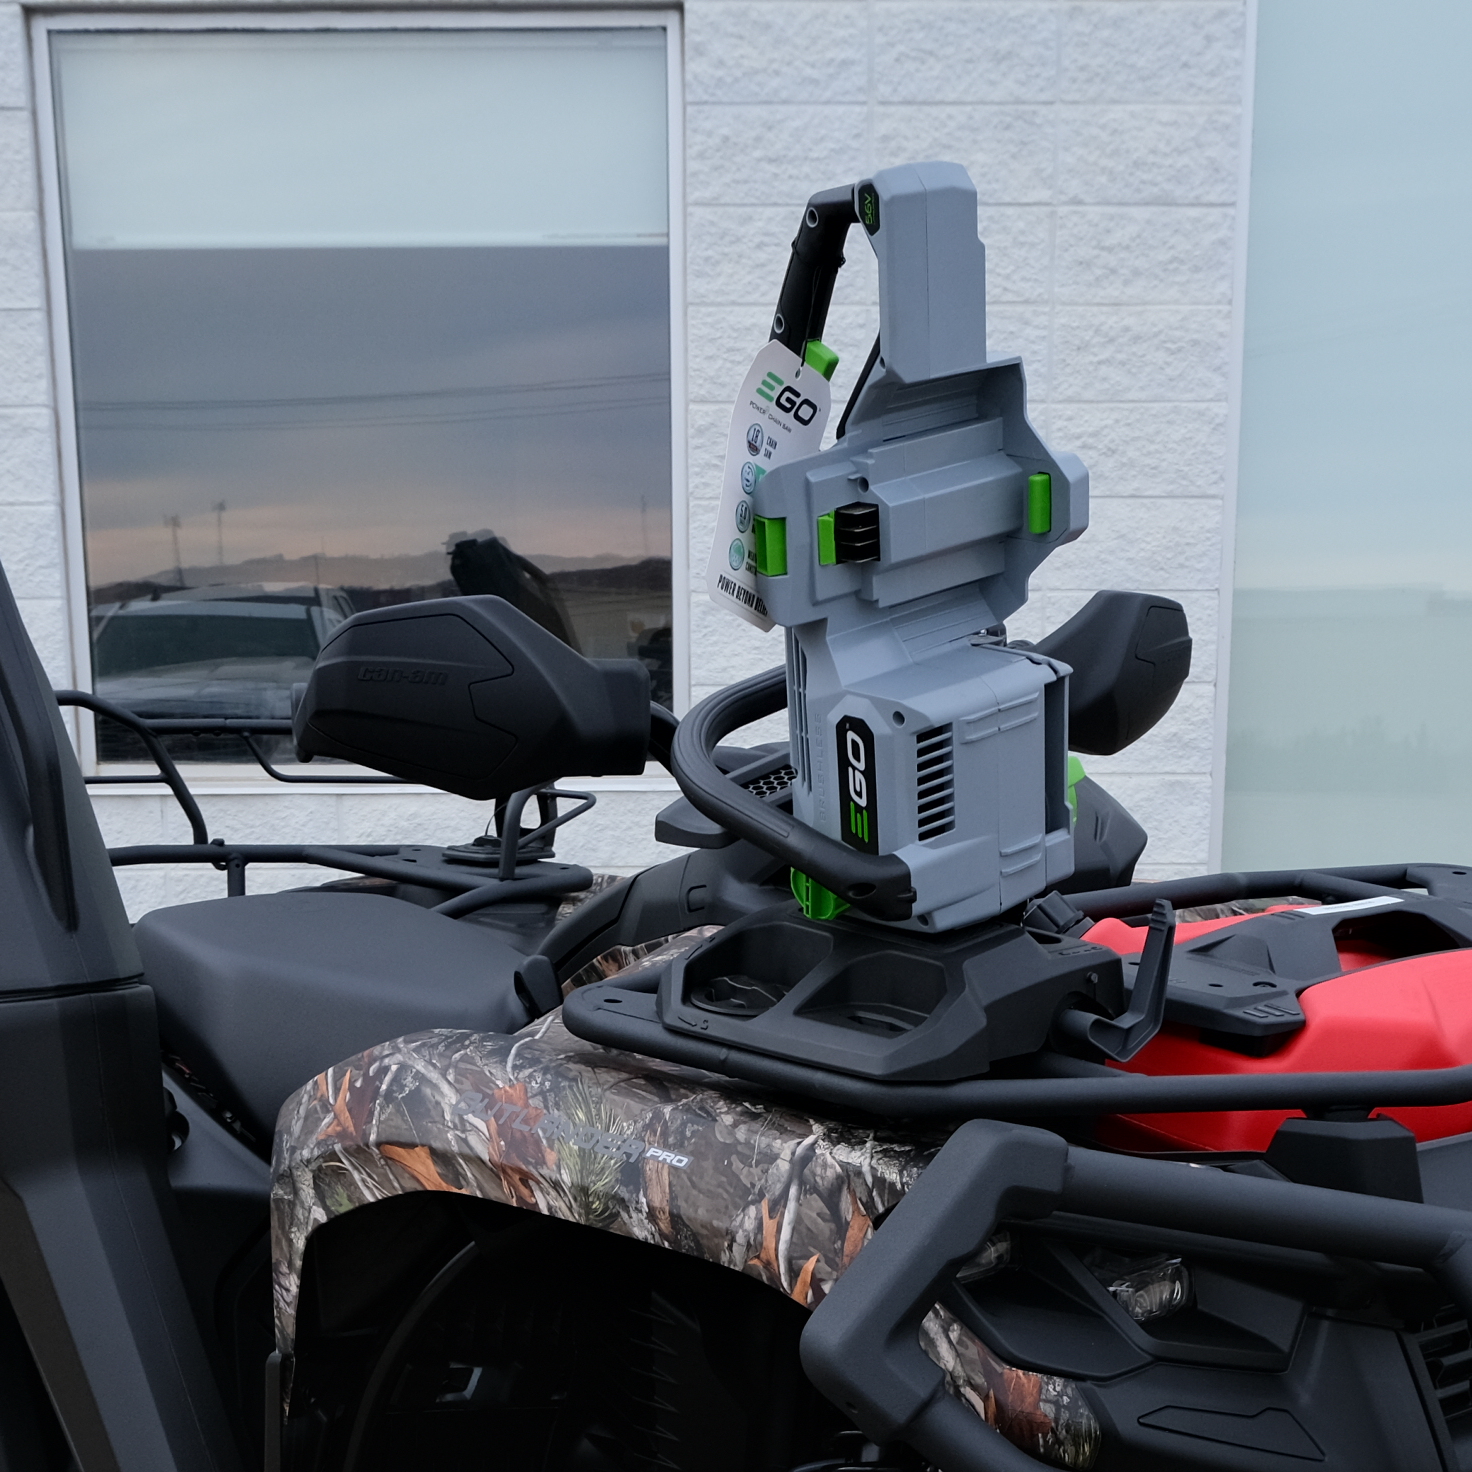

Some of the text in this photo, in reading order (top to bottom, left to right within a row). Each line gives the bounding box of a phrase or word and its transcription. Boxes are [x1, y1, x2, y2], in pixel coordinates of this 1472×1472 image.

[864, 193, 873, 224] 56V
[756, 371, 818, 426] EGO
[717, 574, 736, 597] POWER
[735, 585, 756, 608] BEYOND
[814, 712, 827, 822] BRUSHLESS
[846, 729, 868, 843] EGO
[452, 1091, 691, 1168] OUTLANDER PRO
